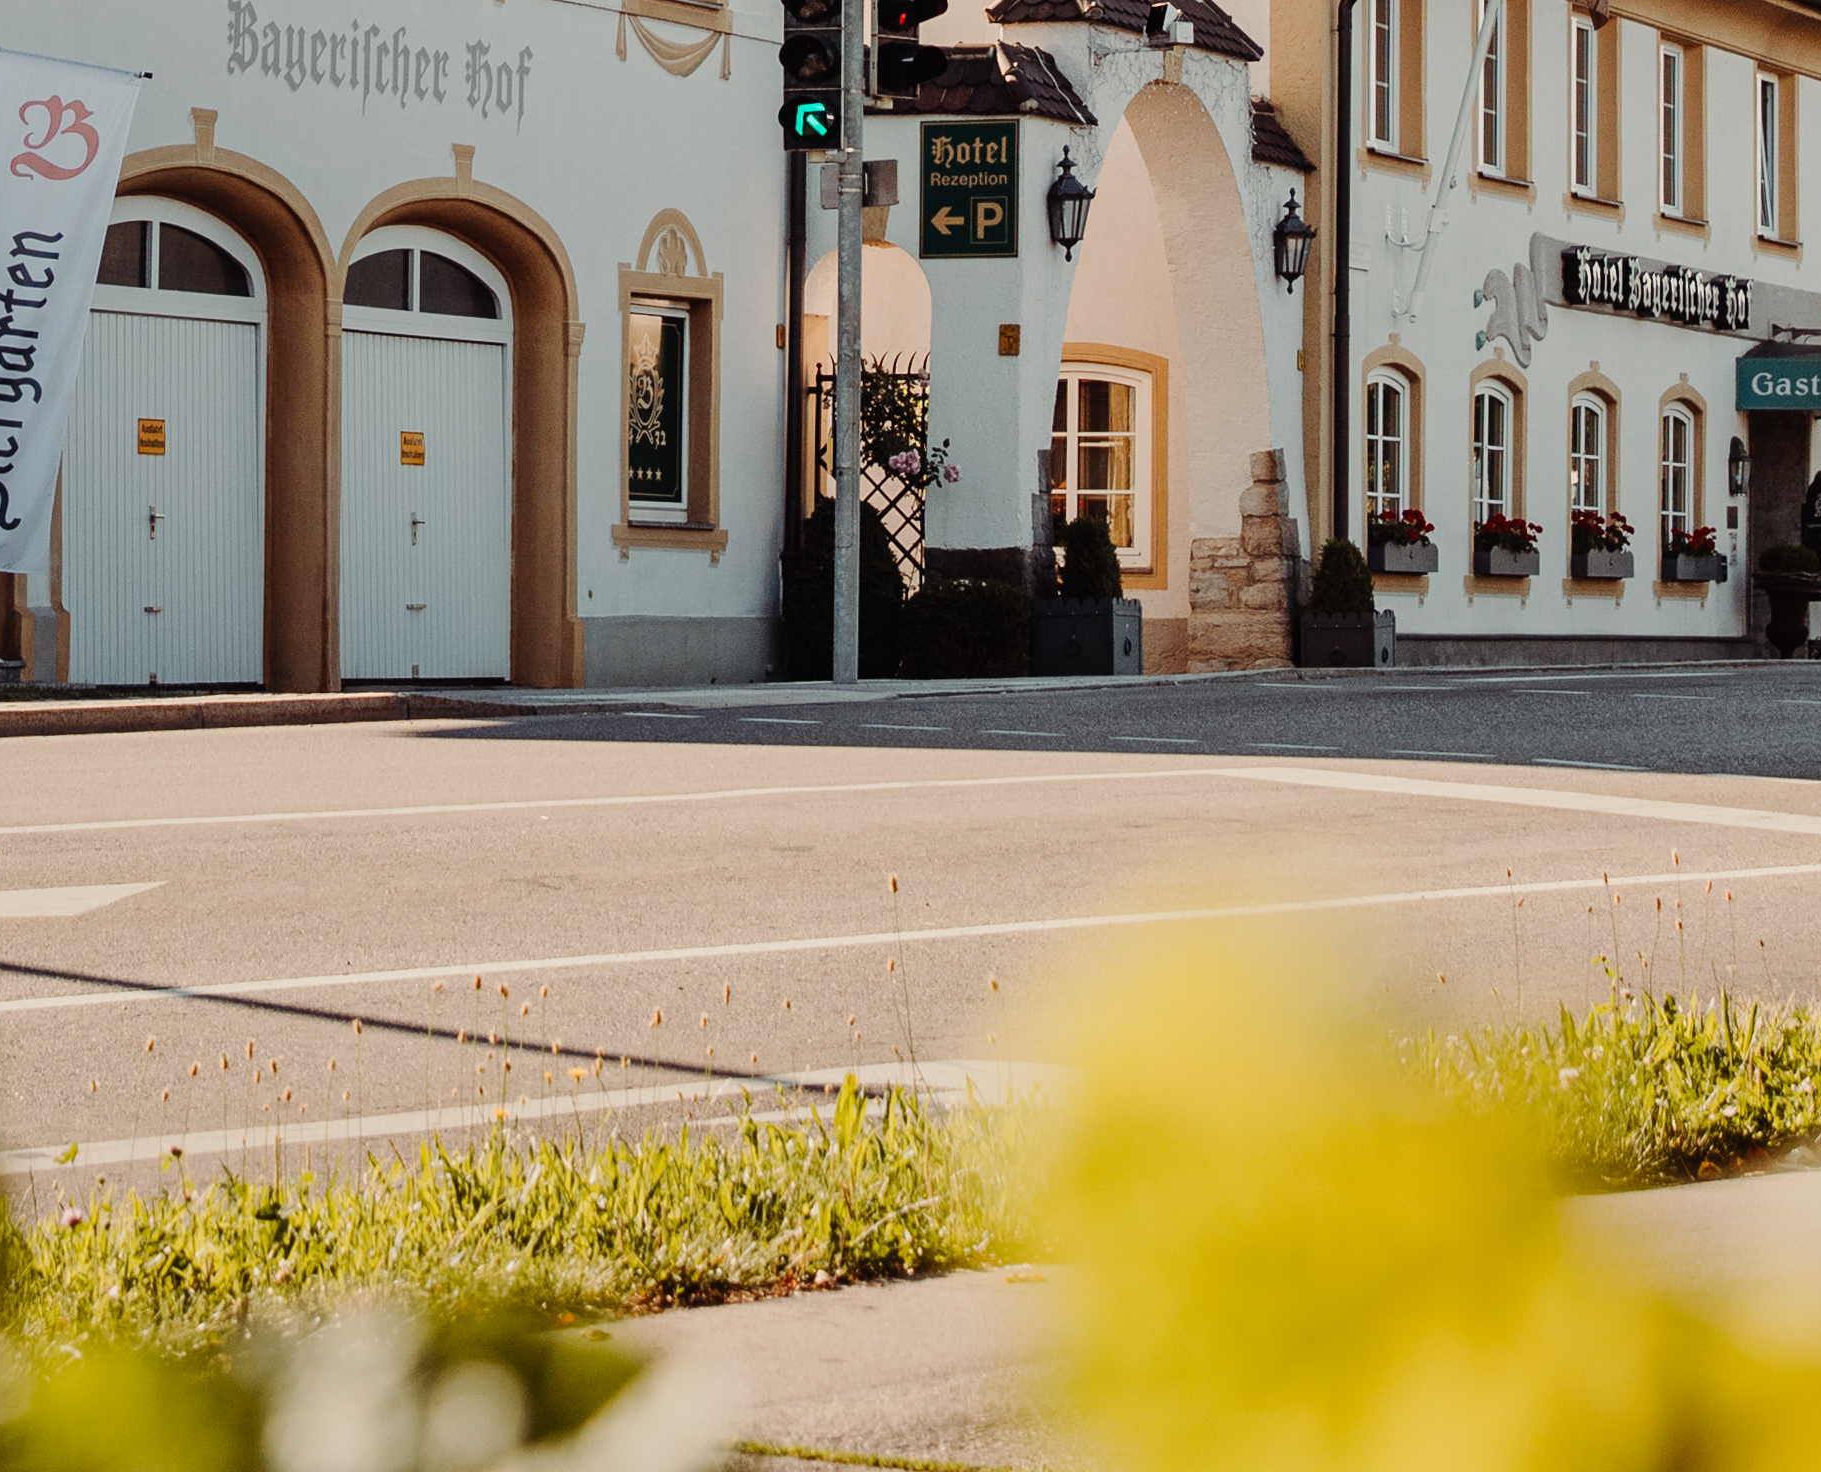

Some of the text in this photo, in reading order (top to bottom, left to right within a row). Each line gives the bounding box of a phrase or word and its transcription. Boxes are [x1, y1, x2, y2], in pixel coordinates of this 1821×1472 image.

[464, 38, 534, 136] Hof
[931, 136, 1007, 168] Hotel
[930, 172, 1007, 188] Rezeption
[977, 202, 1003, 239] P
[1577, 245, 1624, 305] Hotel
[1725, 274, 1754, 331] Hof
